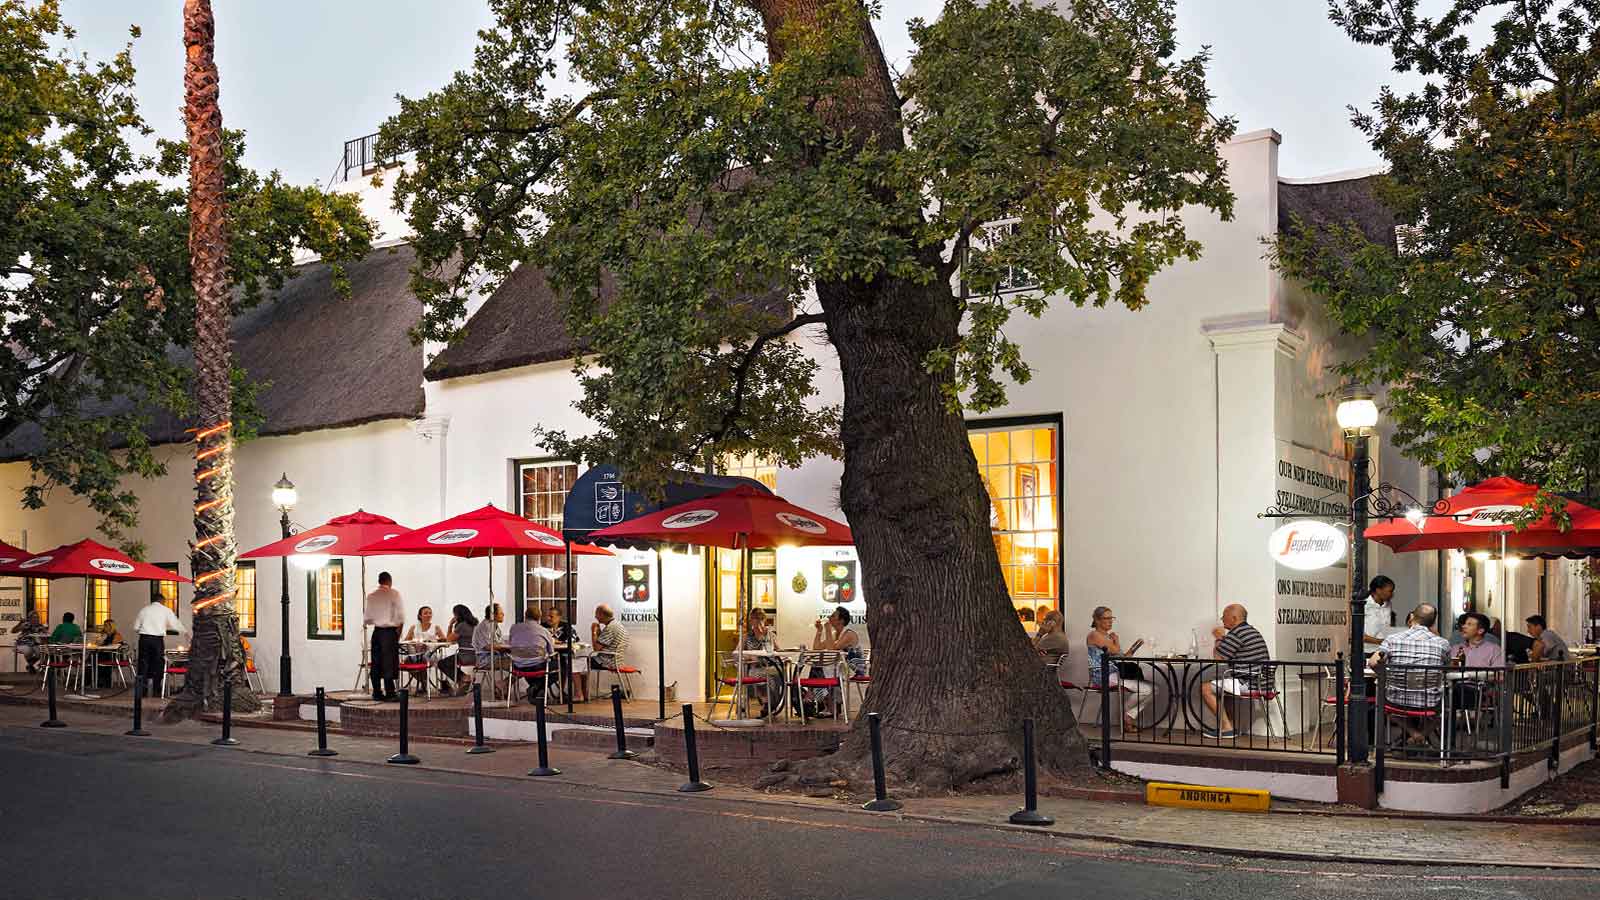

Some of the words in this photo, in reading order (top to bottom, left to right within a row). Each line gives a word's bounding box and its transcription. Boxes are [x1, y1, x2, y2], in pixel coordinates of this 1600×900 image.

[1279, 460, 1292, 479] OUR
[1294, 465, 1306, 482] NEW
[1307, 470, 1347, 494] RESTAURANT
[1280, 530, 1335, 556] Segafredo
[1278, 579, 1291, 595] ONS
[1310, 582, 1346, 599] RESTAURANT
[1277, 608, 1321, 625] STELLENBOSCH
[1296, 638, 1303, 653] IS
